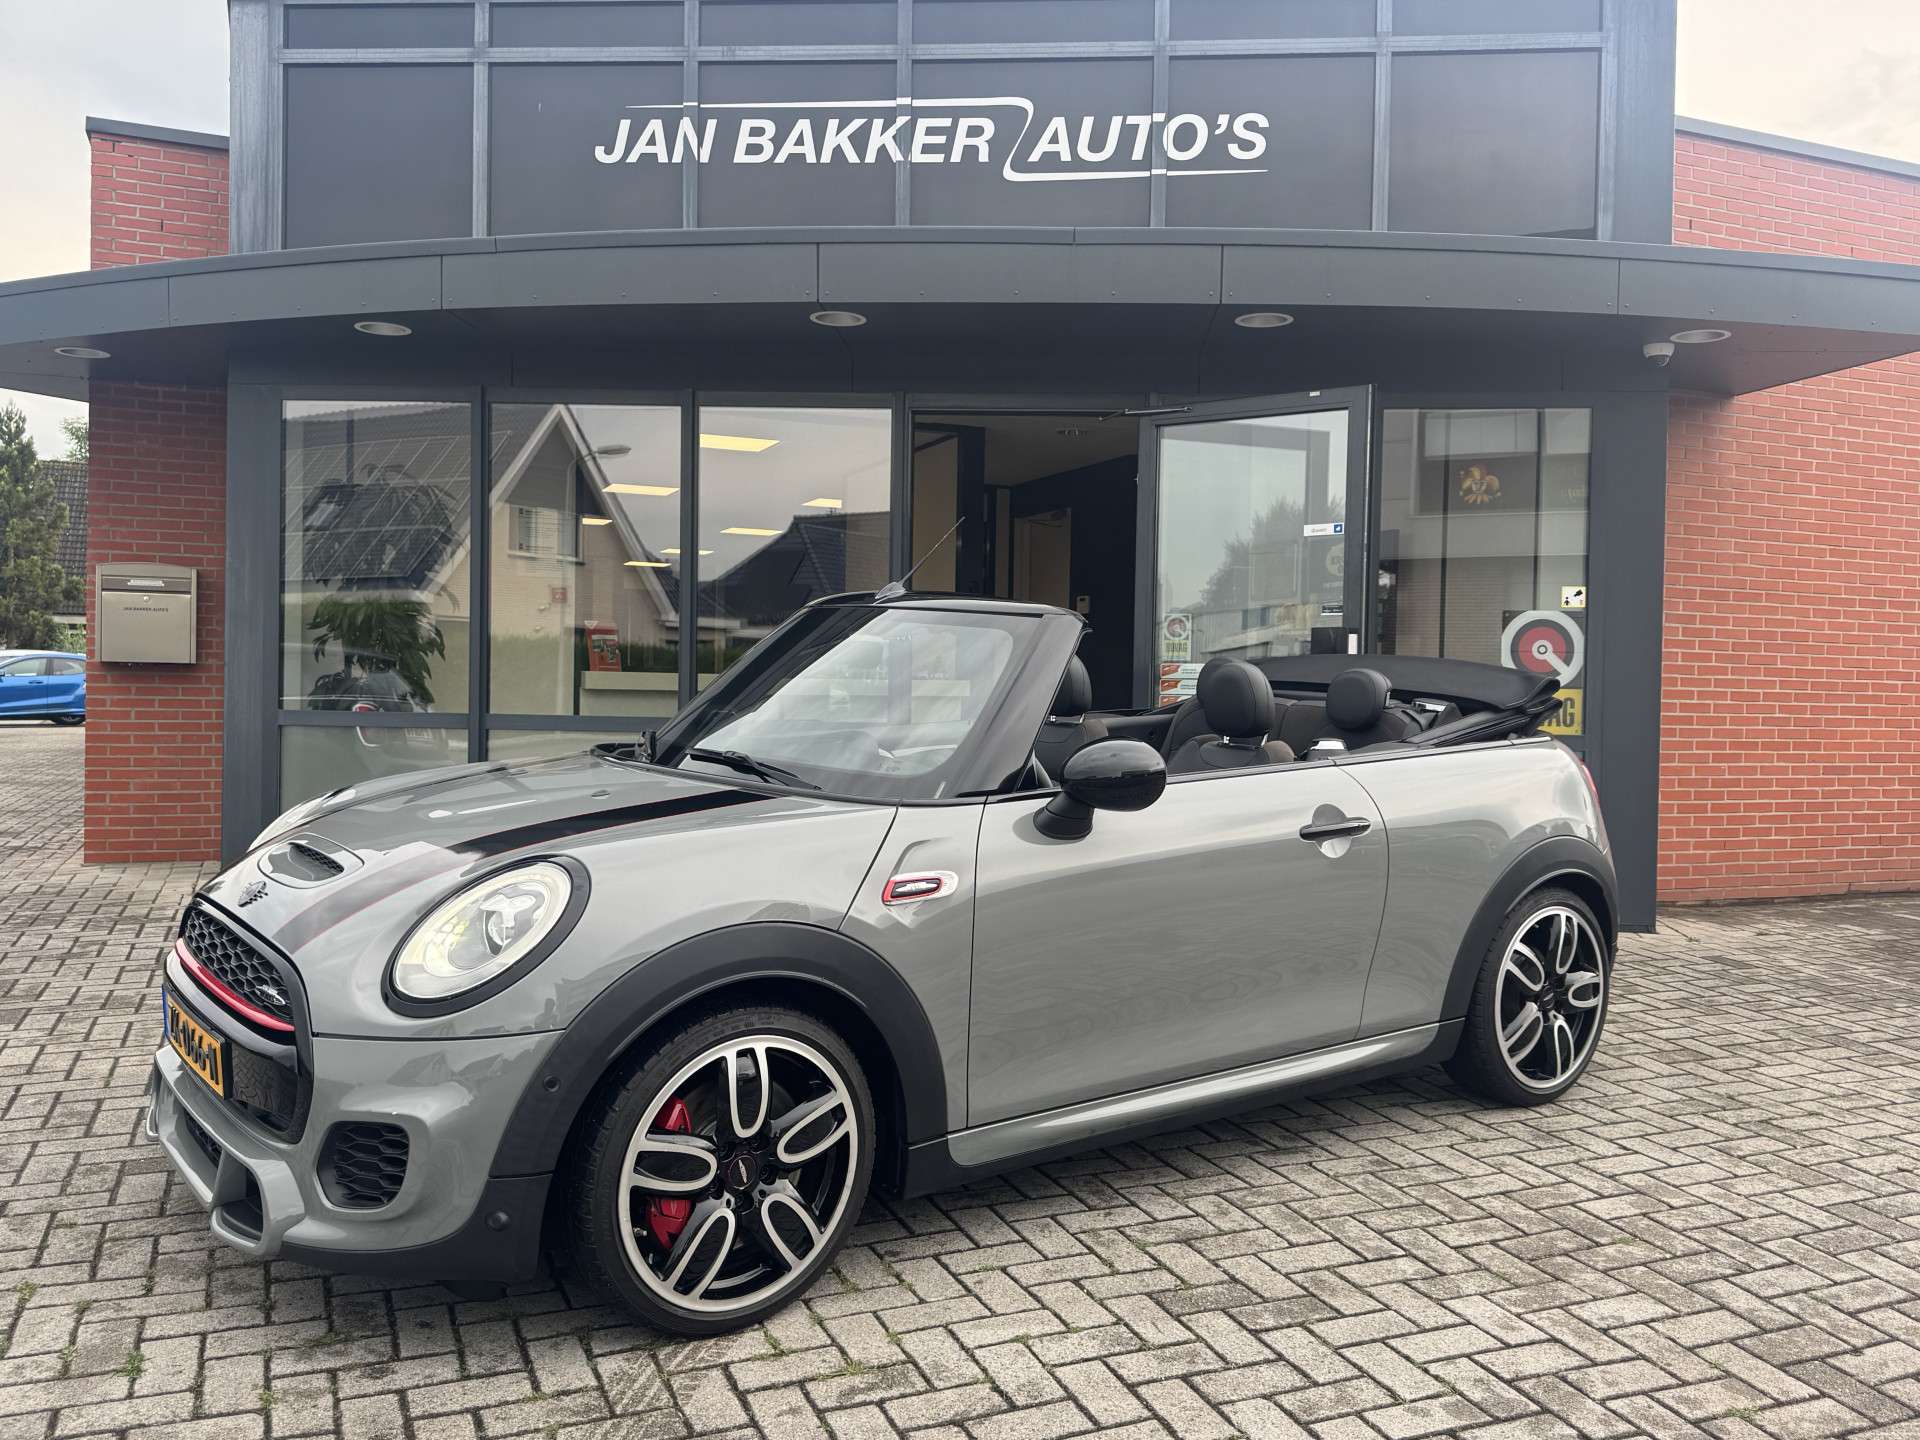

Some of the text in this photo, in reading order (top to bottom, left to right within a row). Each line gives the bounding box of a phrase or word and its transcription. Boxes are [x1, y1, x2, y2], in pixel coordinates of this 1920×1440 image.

[594, 112, 1270, 164] JAN BAKKER AUTO'S
